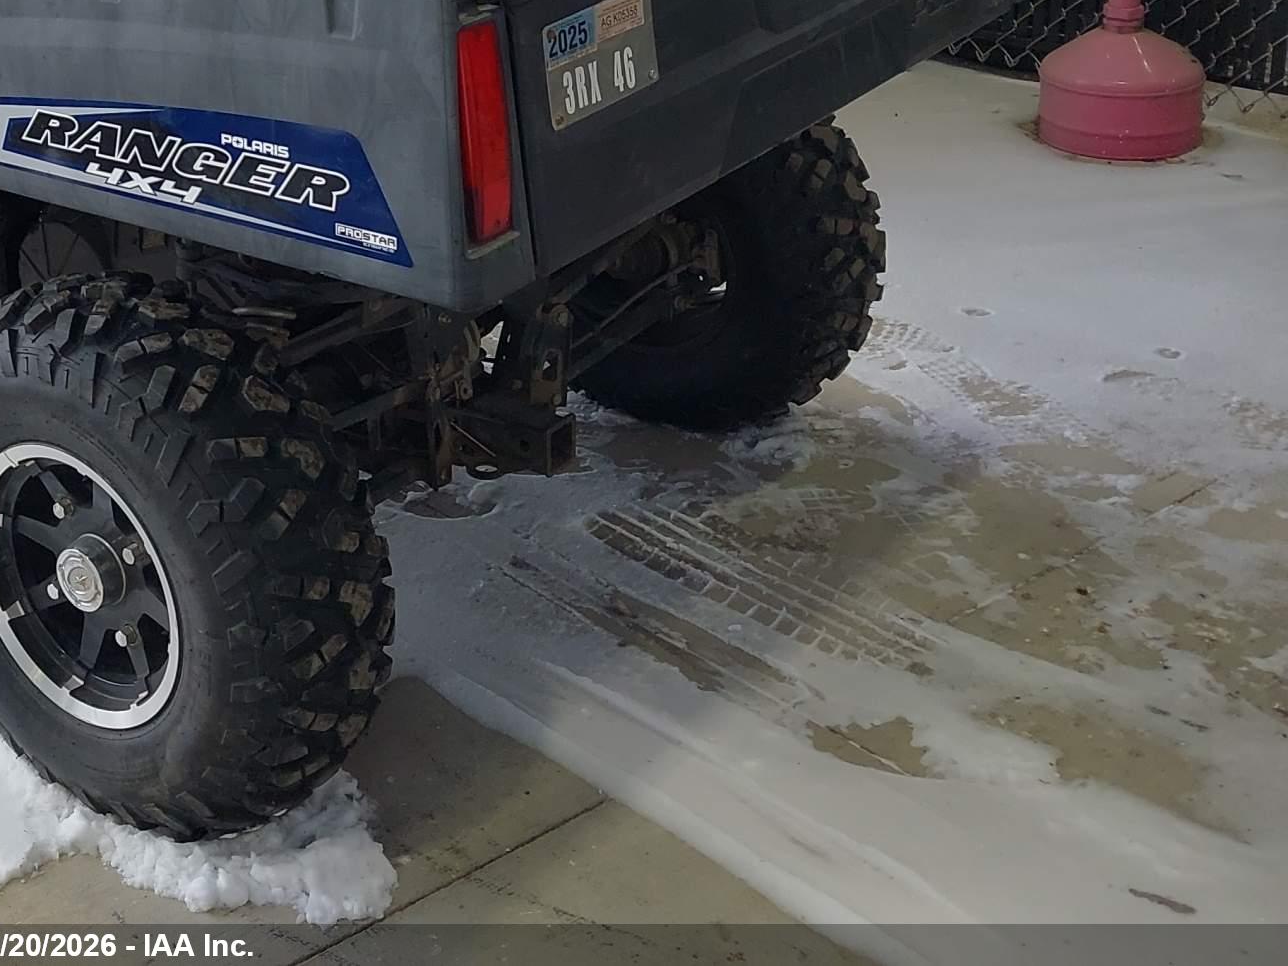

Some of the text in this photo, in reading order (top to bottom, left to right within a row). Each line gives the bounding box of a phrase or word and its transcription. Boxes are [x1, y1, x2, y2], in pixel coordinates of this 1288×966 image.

[547, 21, 588, 59] 2025
[562, 46, 636, 115] 3RX 46
[21, 109, 350, 212] RANGER
[220, 133, 290, 158] POLARIS
[336, 223, 397, 250] PROSTAR
